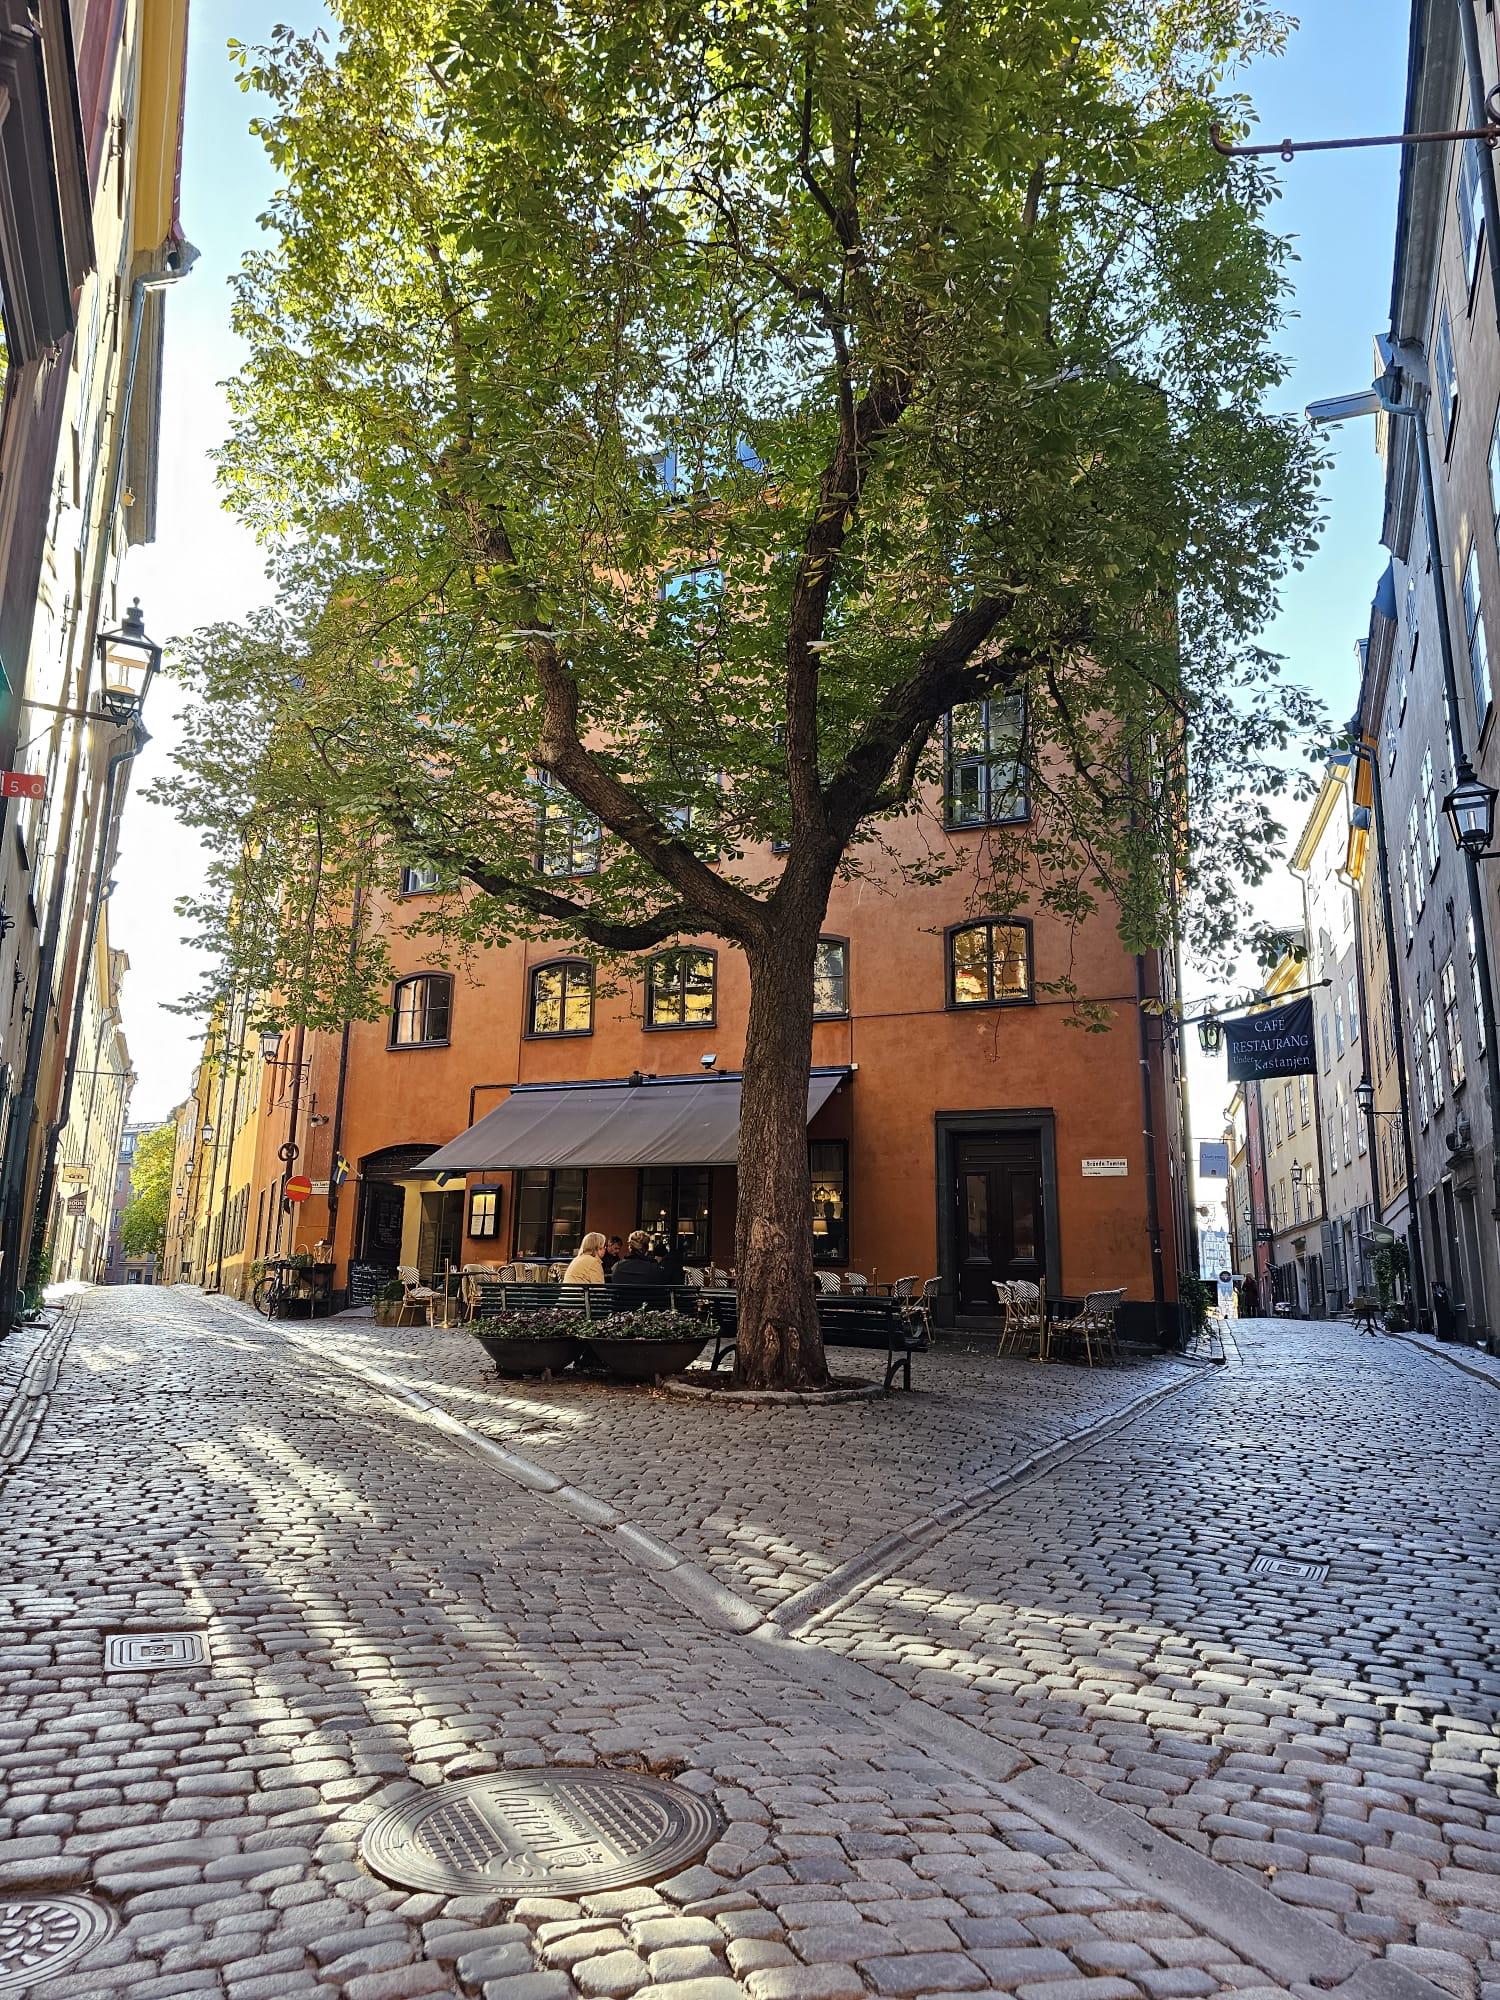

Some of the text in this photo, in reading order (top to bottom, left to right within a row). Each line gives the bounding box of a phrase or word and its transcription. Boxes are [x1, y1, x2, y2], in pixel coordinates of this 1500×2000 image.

[1254, 1016, 1286, 1033] CAFÉ
[1232, 1034, 1309, 1054] RESTAURANG
[1233, 1055, 1311, 1071] Under Kastanjen
